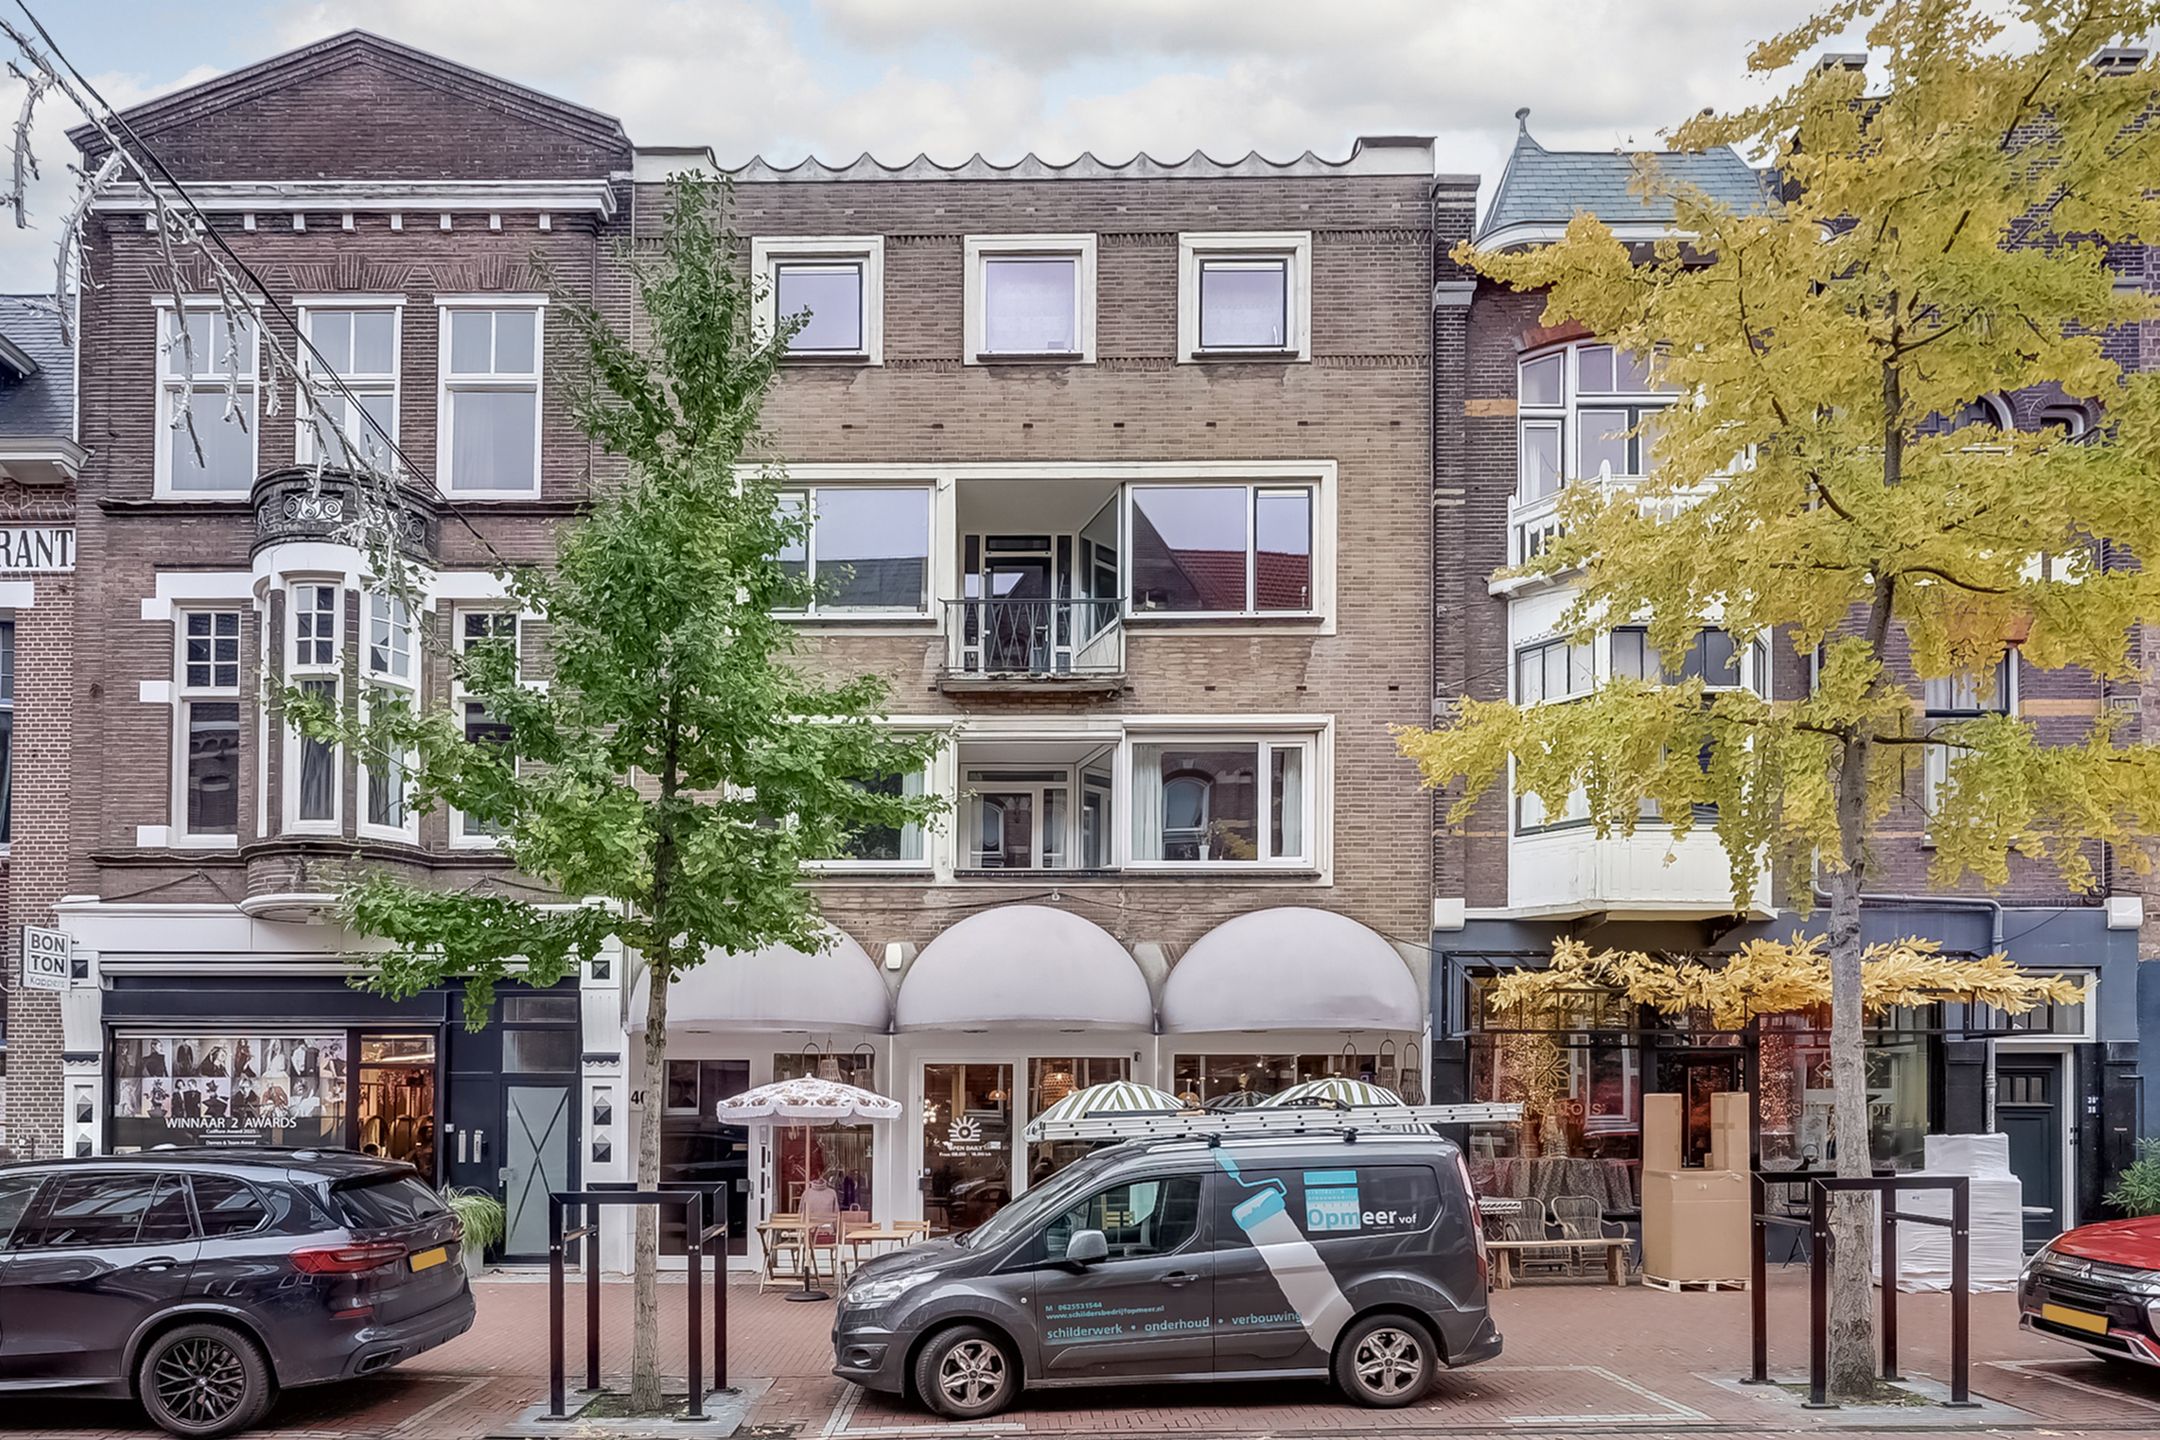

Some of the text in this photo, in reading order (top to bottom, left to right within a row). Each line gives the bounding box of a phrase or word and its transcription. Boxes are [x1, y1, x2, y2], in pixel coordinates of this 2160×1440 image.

[31, 934, 65, 953] BON
[31, 955, 65, 974] TON
[165, 1116, 297, 1129] WINNAAR 2 AWARDS
[1308, 1208, 1417, 1230] Opmeer vof
[1046, 1305, 1165, 1320] www.schildersbedrijfopmeer.nl
[1047, 1311, 1302, 1339] schilderwerk onderhoud verbouwing
